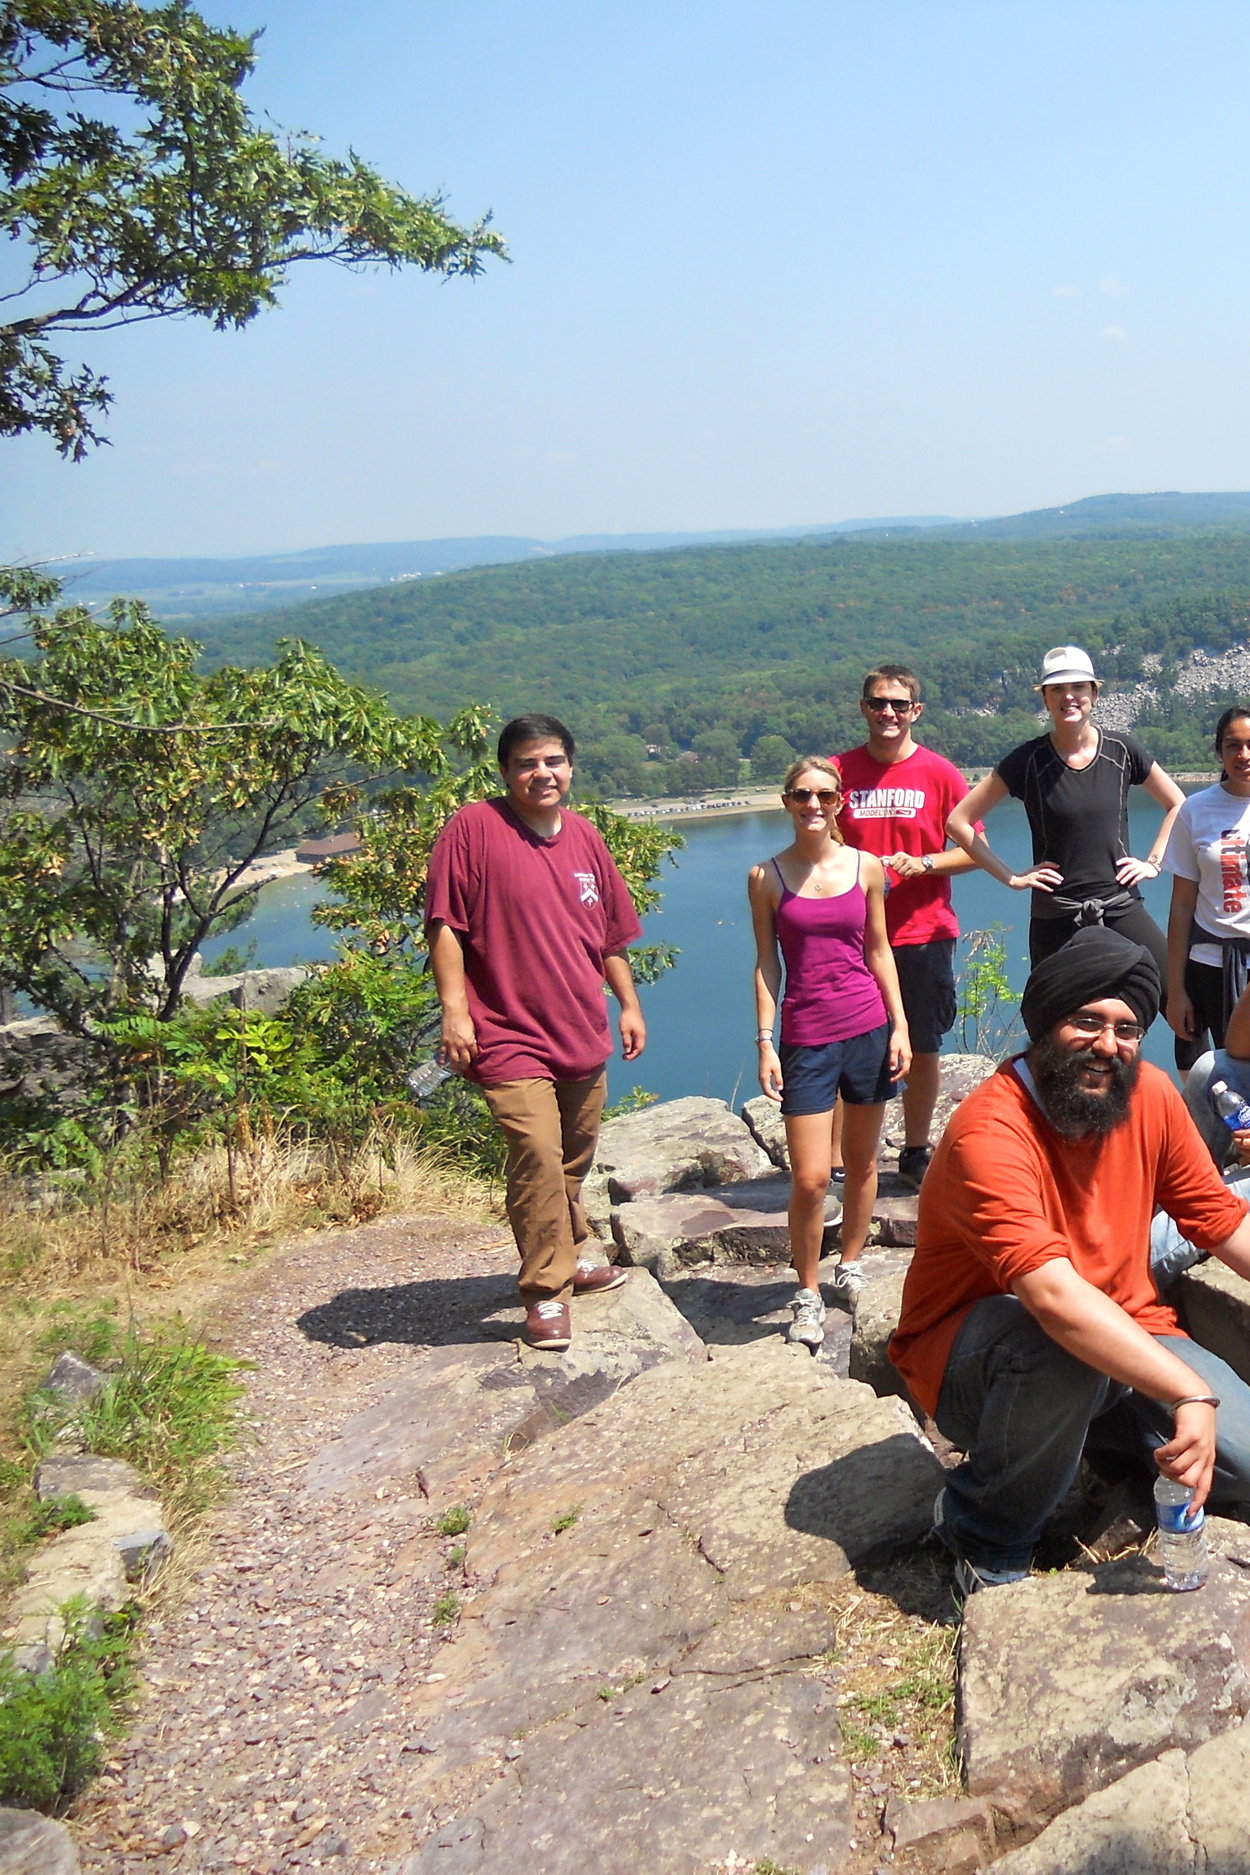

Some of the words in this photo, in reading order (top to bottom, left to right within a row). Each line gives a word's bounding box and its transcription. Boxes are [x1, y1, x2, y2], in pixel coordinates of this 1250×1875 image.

[849, 788, 925, 809] STANFORD
[859, 809, 882, 817] MODEL
[1220, 829, 1247, 913] ultimate
